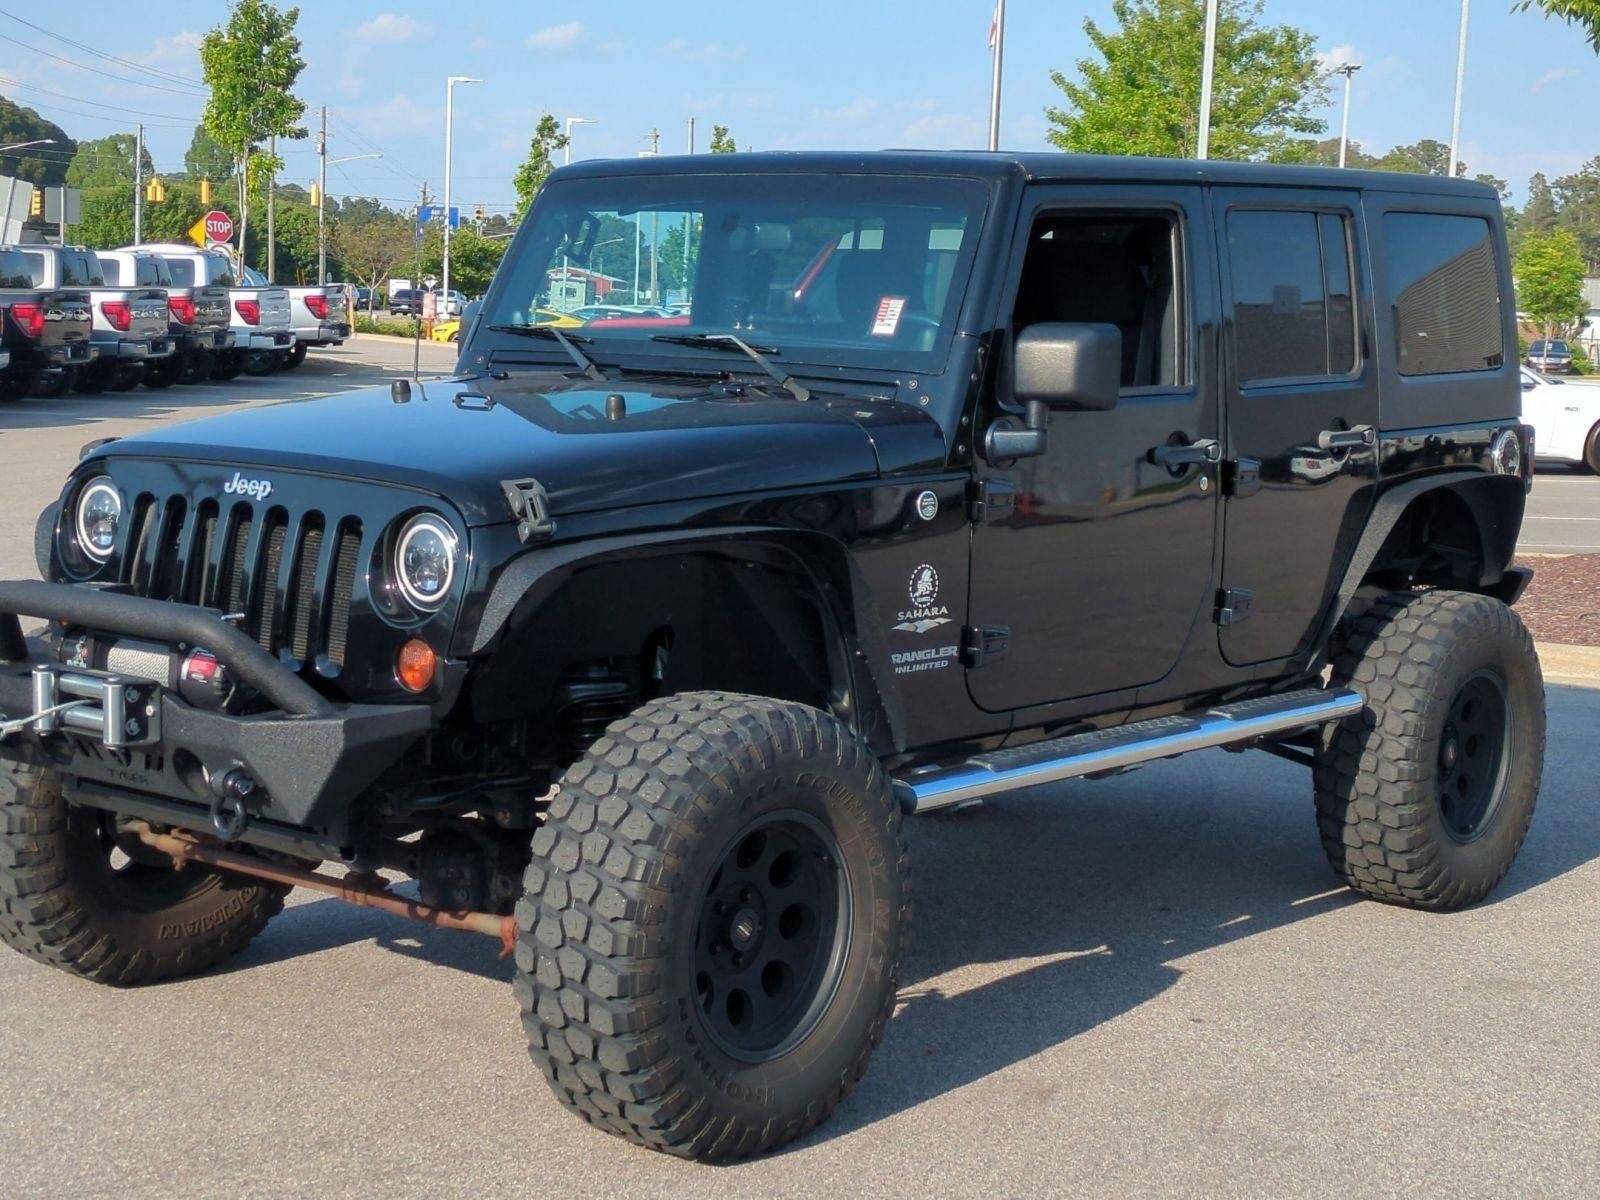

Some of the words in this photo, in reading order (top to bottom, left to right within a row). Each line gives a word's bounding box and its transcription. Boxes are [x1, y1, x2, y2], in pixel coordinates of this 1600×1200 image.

[206, 220, 231, 233] STOP
[224, 472, 272, 501] Jeep
[897, 606, 949, 621] SAHARA
